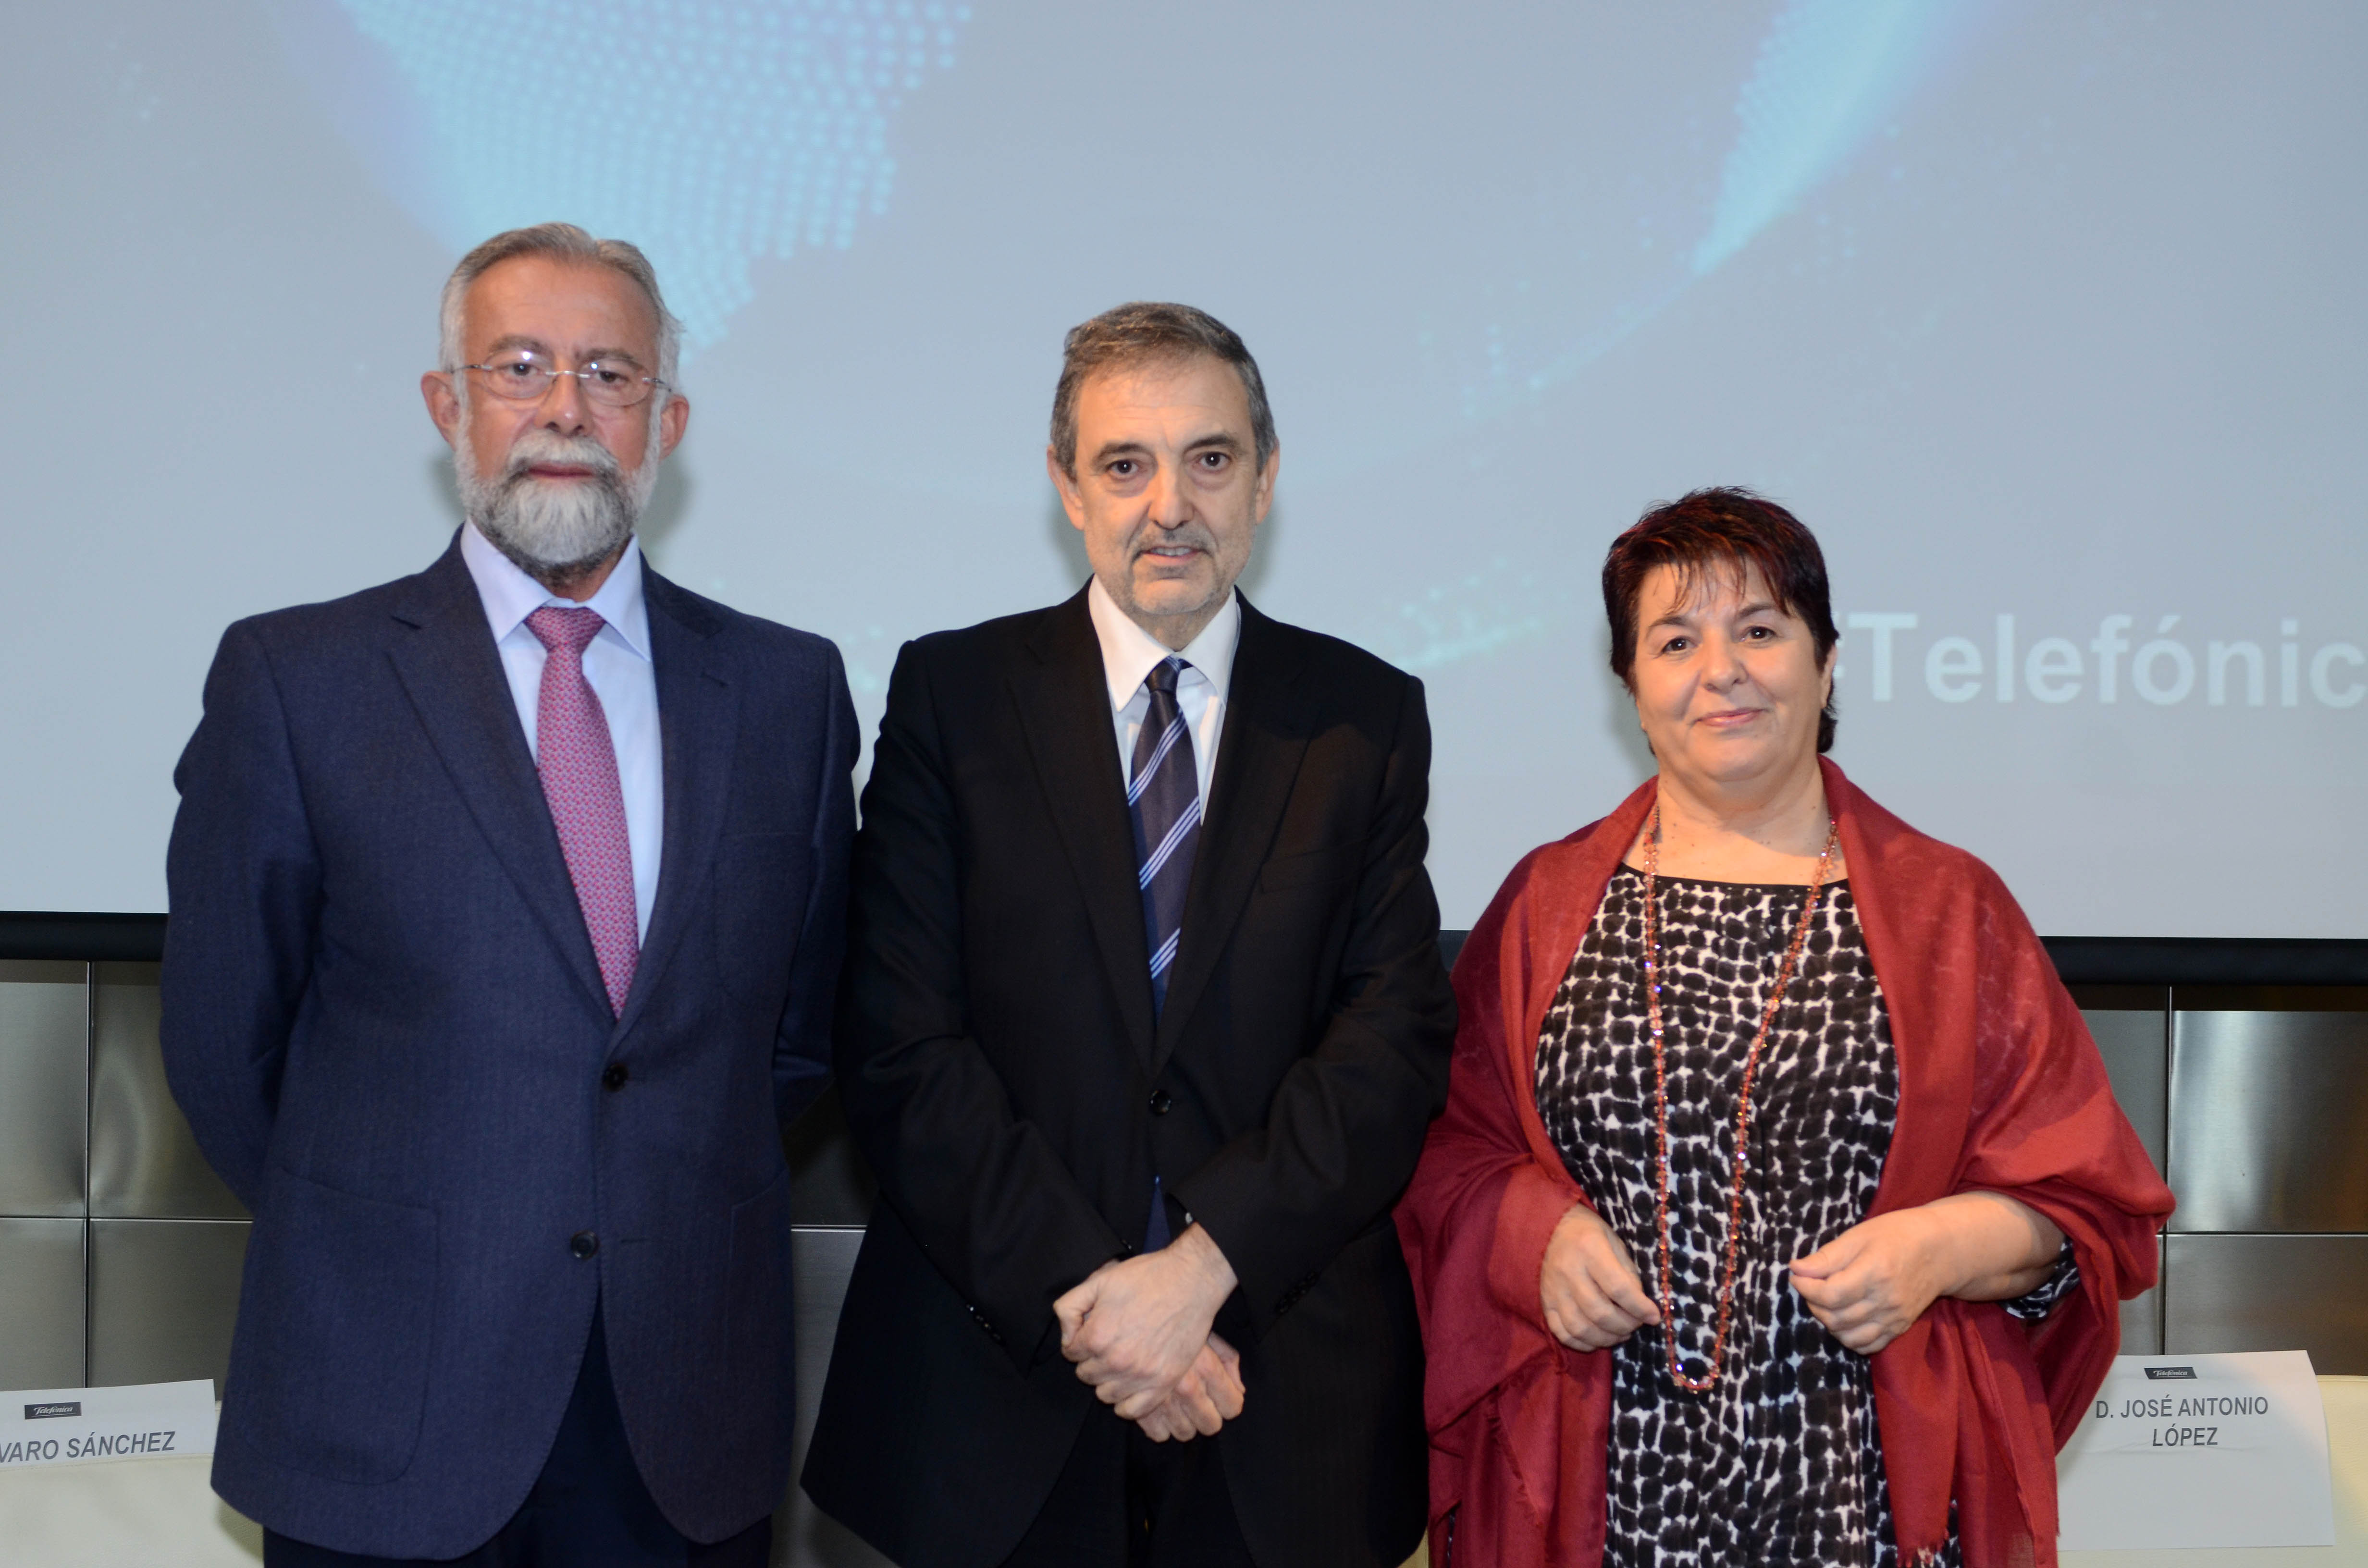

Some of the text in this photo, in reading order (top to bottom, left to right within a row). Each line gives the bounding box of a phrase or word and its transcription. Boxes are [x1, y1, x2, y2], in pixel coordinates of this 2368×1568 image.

[1830, 612, 2367, 709] Telefónic
[2096, 1394, 2269, 1418] D. JOSÉ ANTONIO
[67, 1431, 176, 1458] SÁNCHEZ
[2153, 1423, 2218, 1446] LÓPEZ
